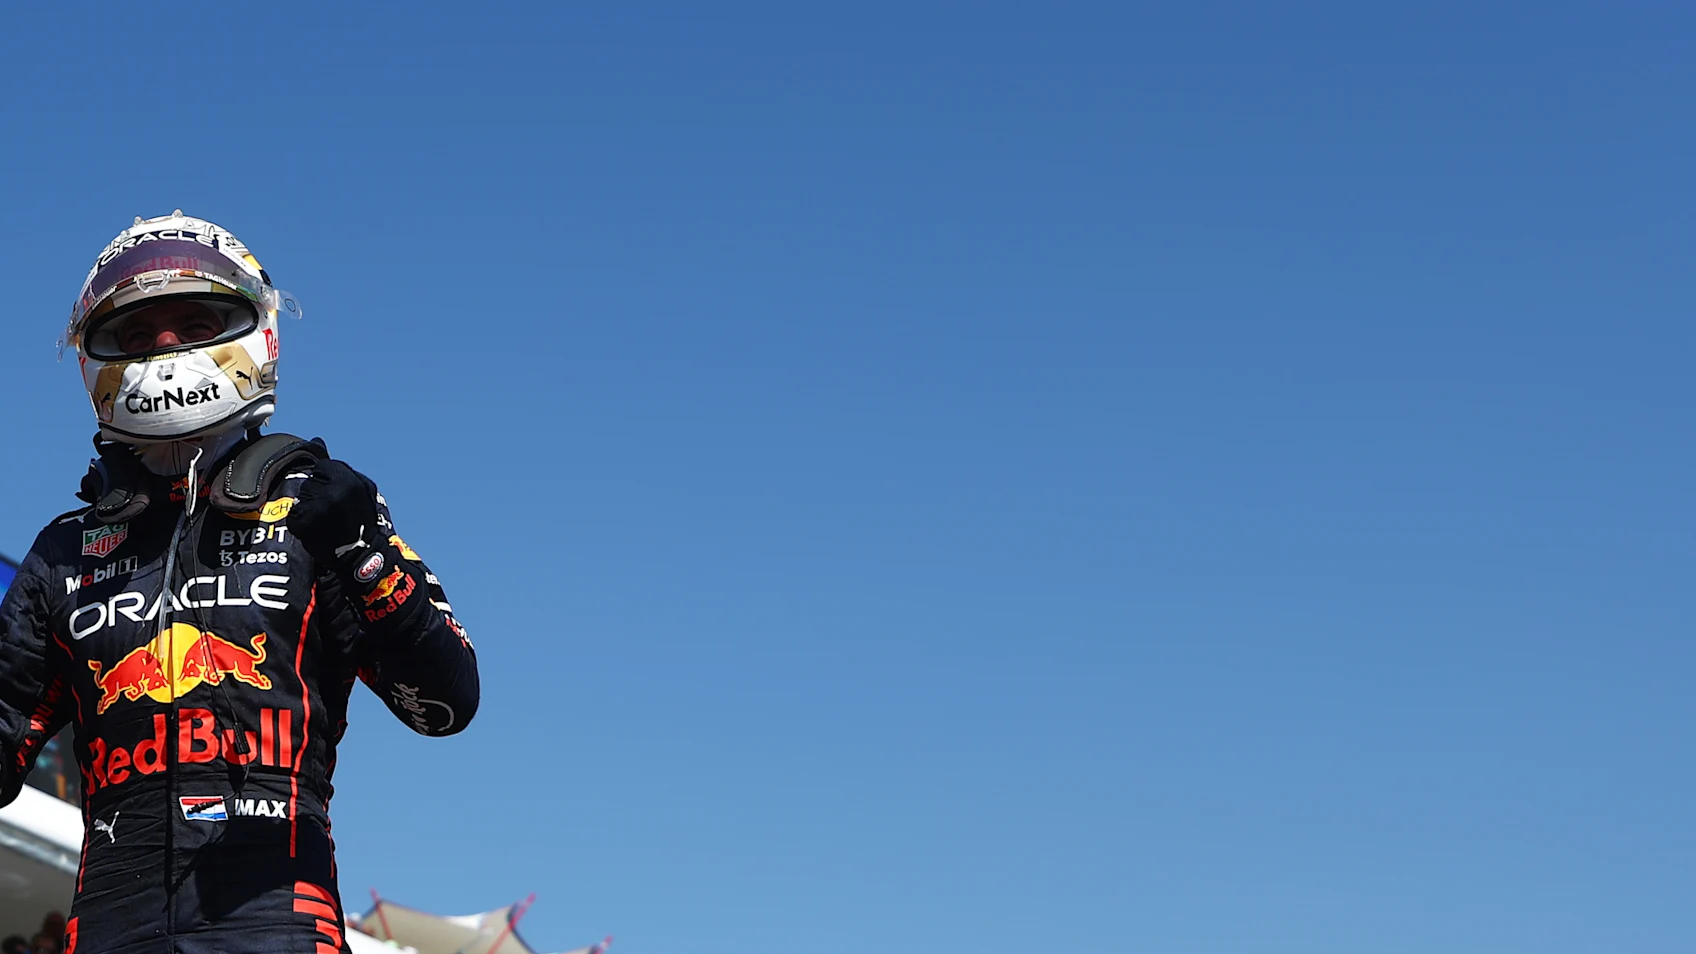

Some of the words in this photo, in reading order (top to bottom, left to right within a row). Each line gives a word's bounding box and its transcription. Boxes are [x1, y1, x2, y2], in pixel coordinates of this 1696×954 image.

[100, 229, 214, 266] ORACLE
[125, 382, 221, 414] CarNext
[85, 533, 127, 557] HEUER
[87, 522, 128, 541] TAG
[219, 525, 288, 547] BYBIT
[238, 550, 288, 565] Tezos
[65, 562, 117, 595] Mobil
[68, 574, 291, 641] ORACLE
[364, 597, 397, 623] Red
[393, 573, 417, 605] Bull
[84, 713, 168, 796] Red
[177, 708, 294, 769] Bull
[234, 798, 287, 820] MAX
